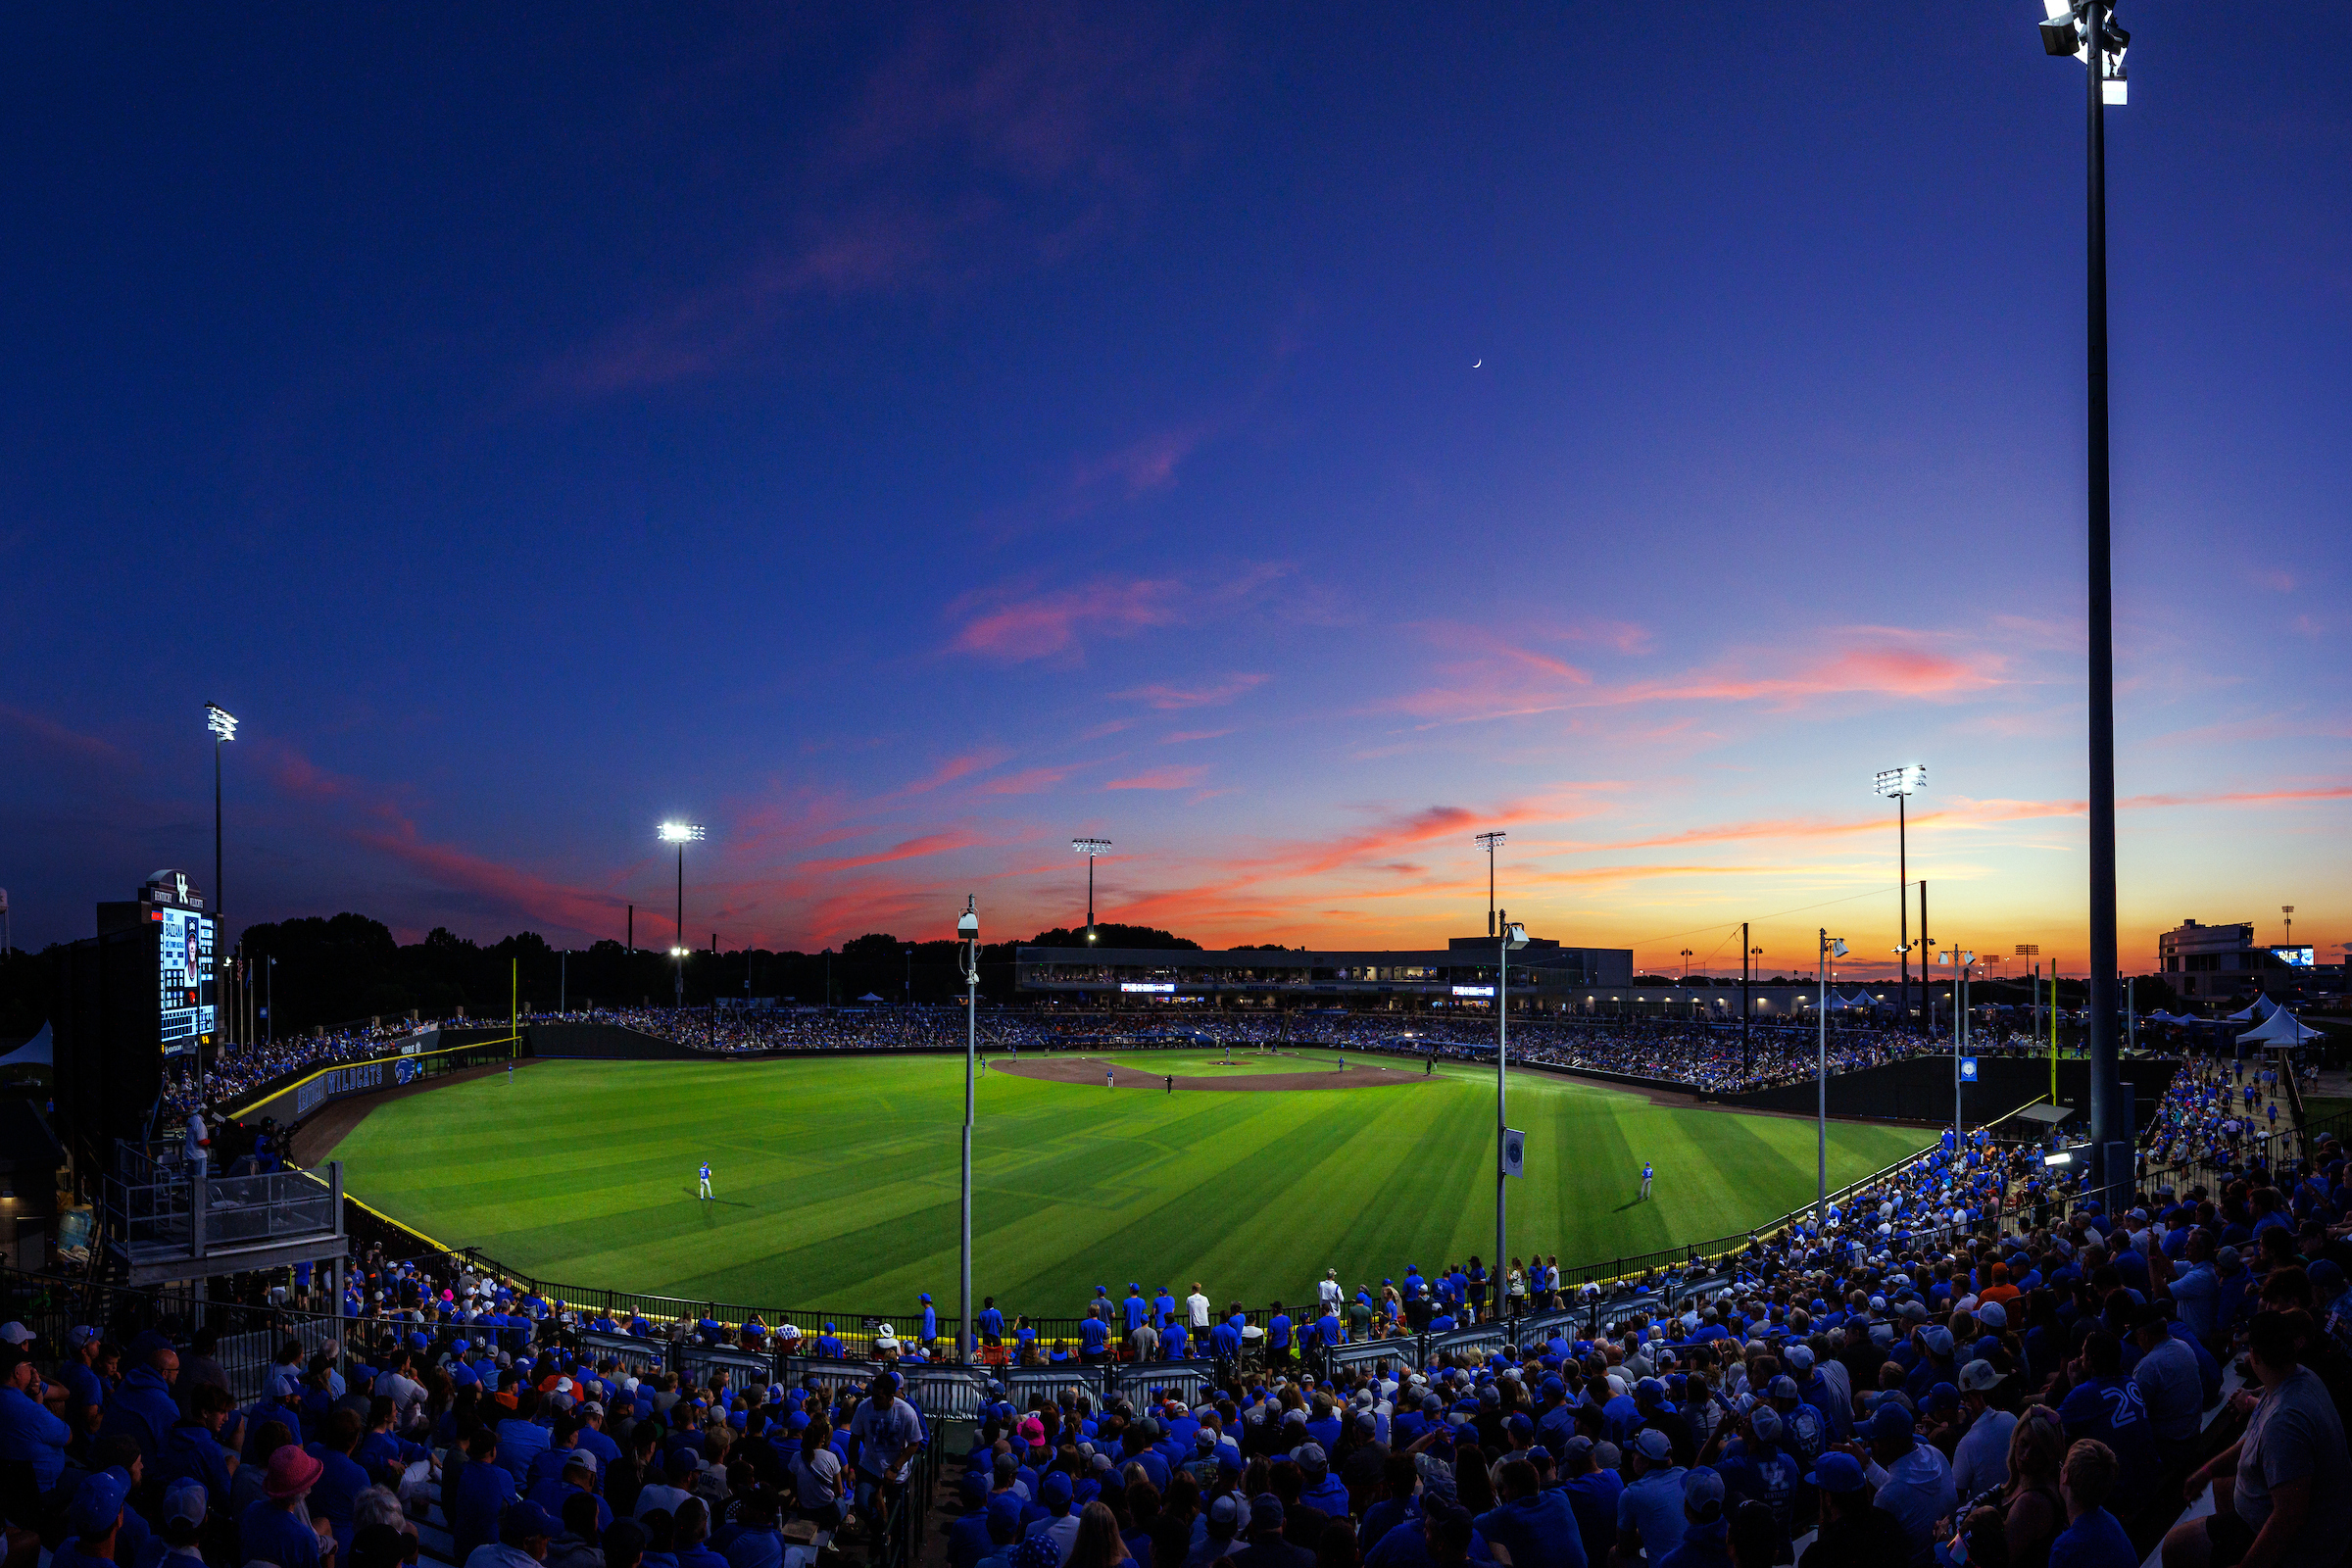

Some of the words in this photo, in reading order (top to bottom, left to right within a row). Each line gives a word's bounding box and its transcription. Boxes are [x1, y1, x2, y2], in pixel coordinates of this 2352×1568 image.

[175, 872, 189, 906] UK
[297, 1075, 324, 1113] KENTUCKY
[327, 1063, 383, 1095] WILDCATS
[2099, 1381, 2148, 1429] 29
[1756, 1461, 1790, 1492] UK
